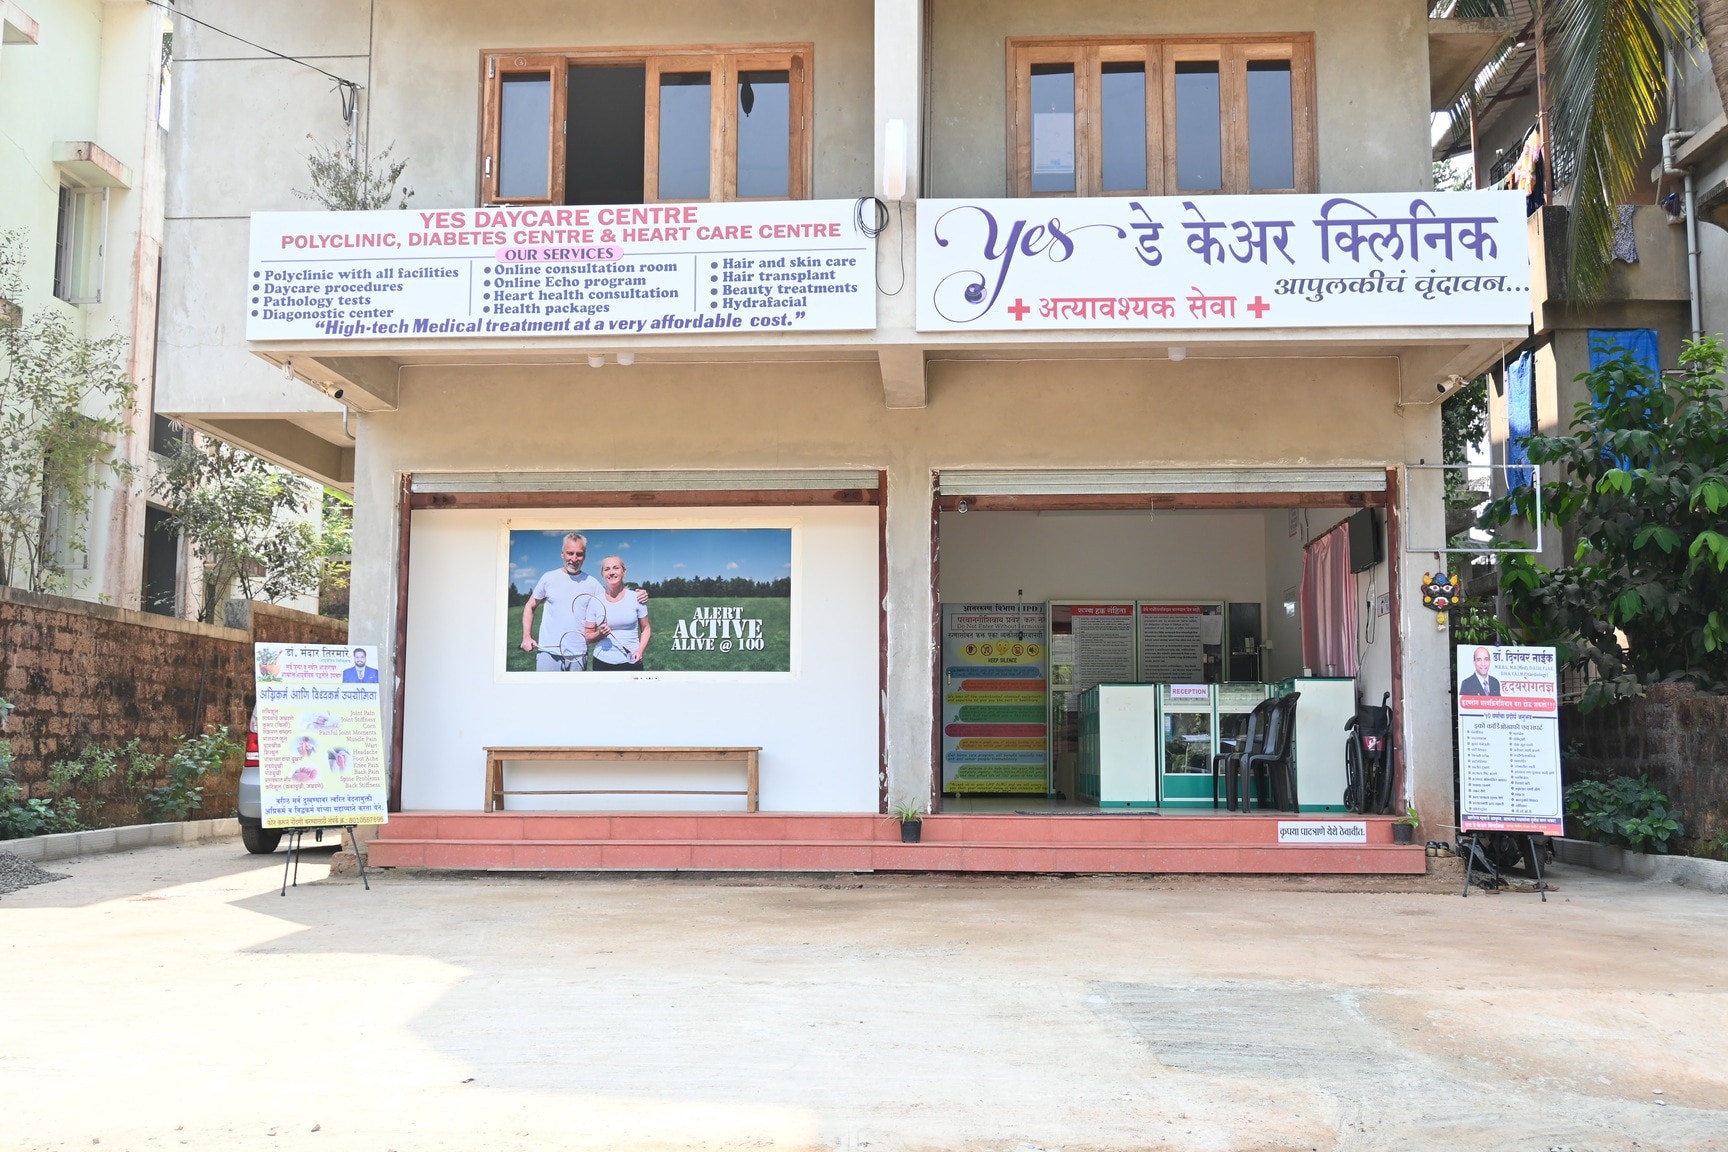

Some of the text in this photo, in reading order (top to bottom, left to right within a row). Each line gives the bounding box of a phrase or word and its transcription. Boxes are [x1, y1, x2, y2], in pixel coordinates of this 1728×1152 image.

[420, 206, 698, 229] YES DAYCARE CENTRE
[281, 222, 841, 250] POLYCLINIC, DIABETES CENTRE & HEART CARE CENTRE
[1129, 201, 1165, 267] डे
[1181, 201, 1296, 265] केअर
[1312, 197, 1499, 264] क्लिनिक
[504, 247, 615, 262] OUR SERVICES
[493, 262, 678, 276] Online consultation room
[722, 256, 858, 270] Hair and skin care
[264, 266, 460, 283] Polyclinic with all facilities
[722, 269, 837, 284] Hair transplant
[263, 281, 404, 296] Daycare procedures
[493, 276, 647, 290] Online Echo program
[722, 282, 858, 298] Beauty treatments
[1274, 269, 1409, 303] आपुलकीचं
[493, 287, 679, 301] Heart health consultation
[263, 295, 372, 309] Pathology tests
[493, 302, 611, 316] Health packages
[722, 296, 808, 311] Hydrafacial
[1038, 286, 1238, 321] अत्यावश्यक सेवा
[262, 307, 394, 322] Diagonostic center
[413, 317, 482, 333] Medical
[486, 318, 571, 333] treatment
[574, 318, 592, 332] at
[594, 319, 605, 331] a
[609, 319, 648, 333] very
[650, 312, 743, 332] affordable
[692, 606, 744, 620] ALERT
[672, 618, 763, 639] ACTIVE
[300, 645, 320, 658] मंदार
[671, 638, 765, 653] ALIVE @ 100
[1532, 650, 1554, 664] नाईक
[290, 686, 310, 701] आणि
[1280, 827, 1299, 839] कृपया
[1327, 825, 1338, 837] येथे
